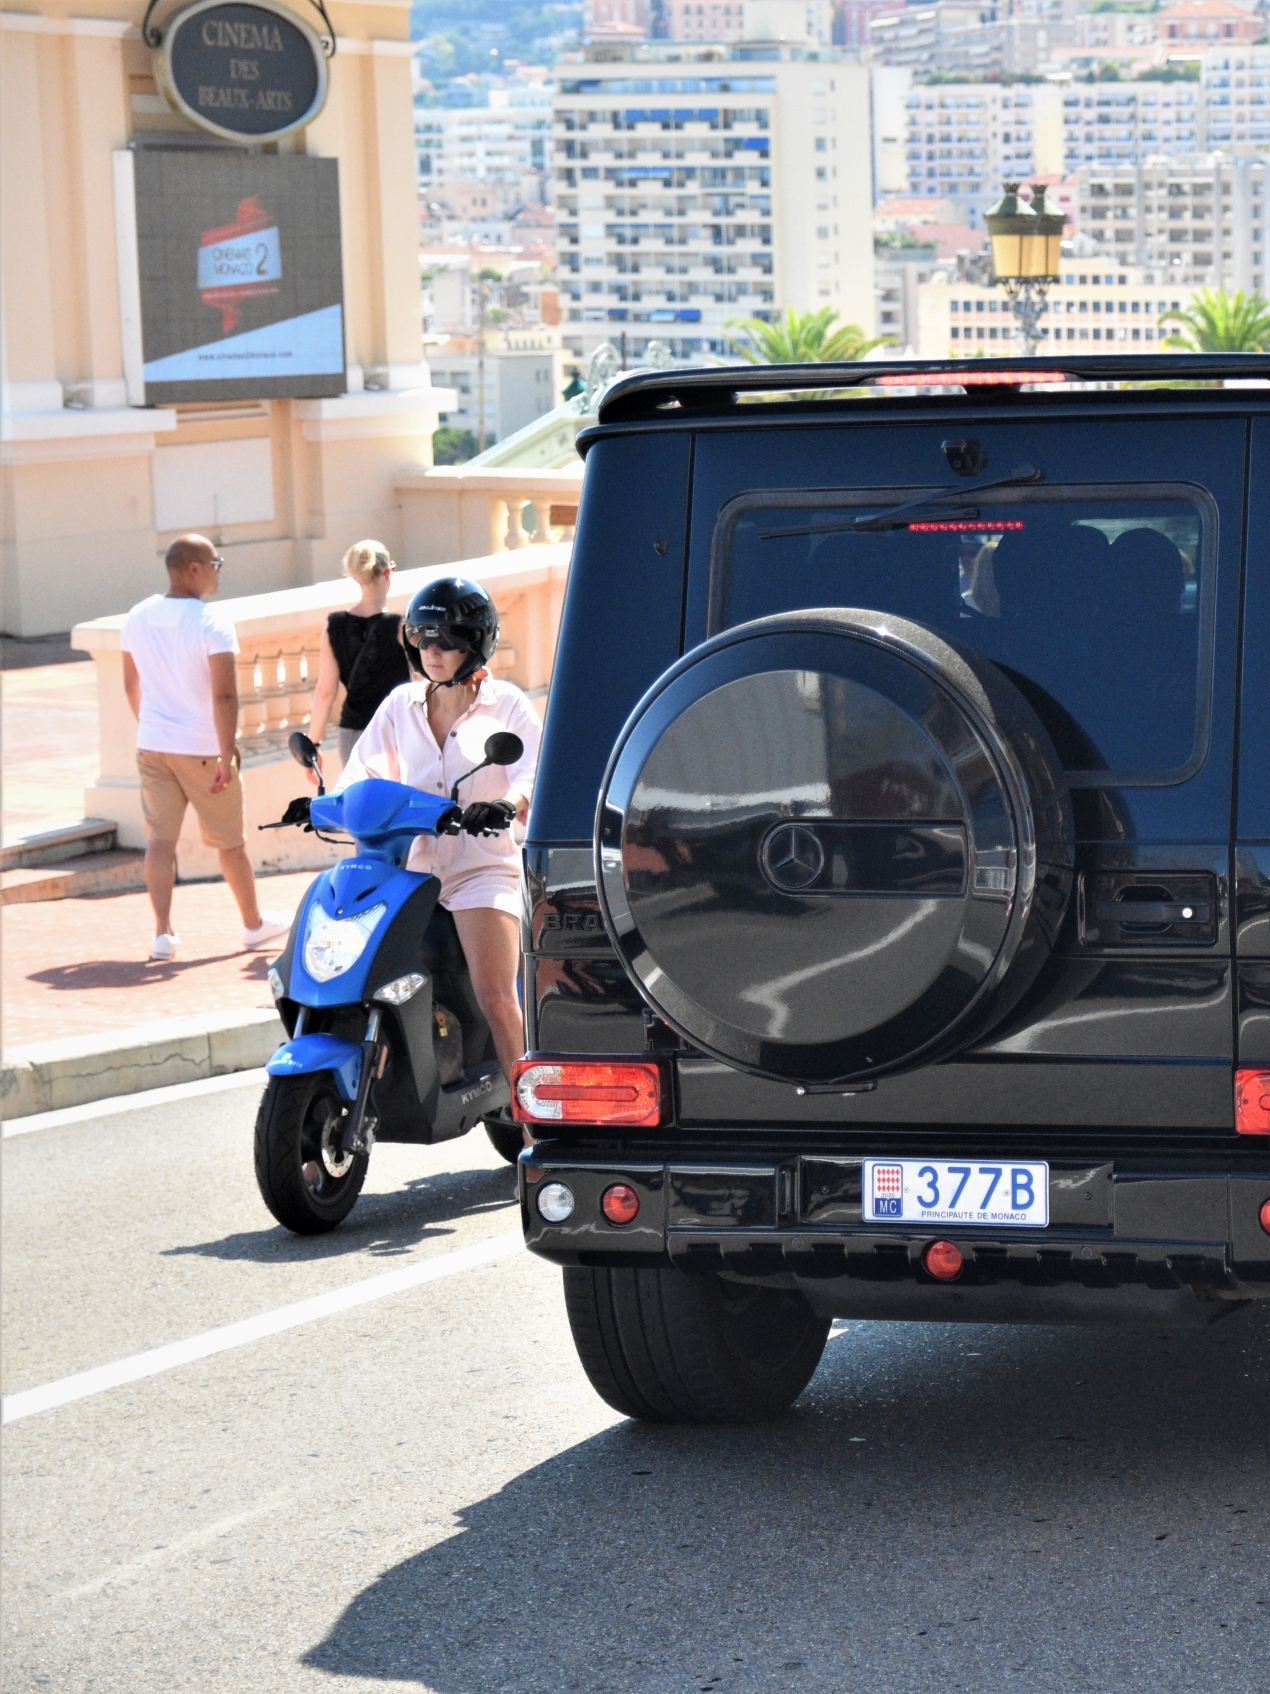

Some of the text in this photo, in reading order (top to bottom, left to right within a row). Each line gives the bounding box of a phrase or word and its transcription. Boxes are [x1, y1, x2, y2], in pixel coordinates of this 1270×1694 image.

[201, 20, 284, 51] CINEMA
[230, 58, 260, 80] DES
[198, 85, 293, 111] BEAUX-ARTS
[255, 242, 269, 275] 2
[917, 1165, 1035, 1210] 377B
[879, 1199, 897, 1214] MC
[921, 1210, 1027, 1221] PRINCIPAUTE DE MONACO
